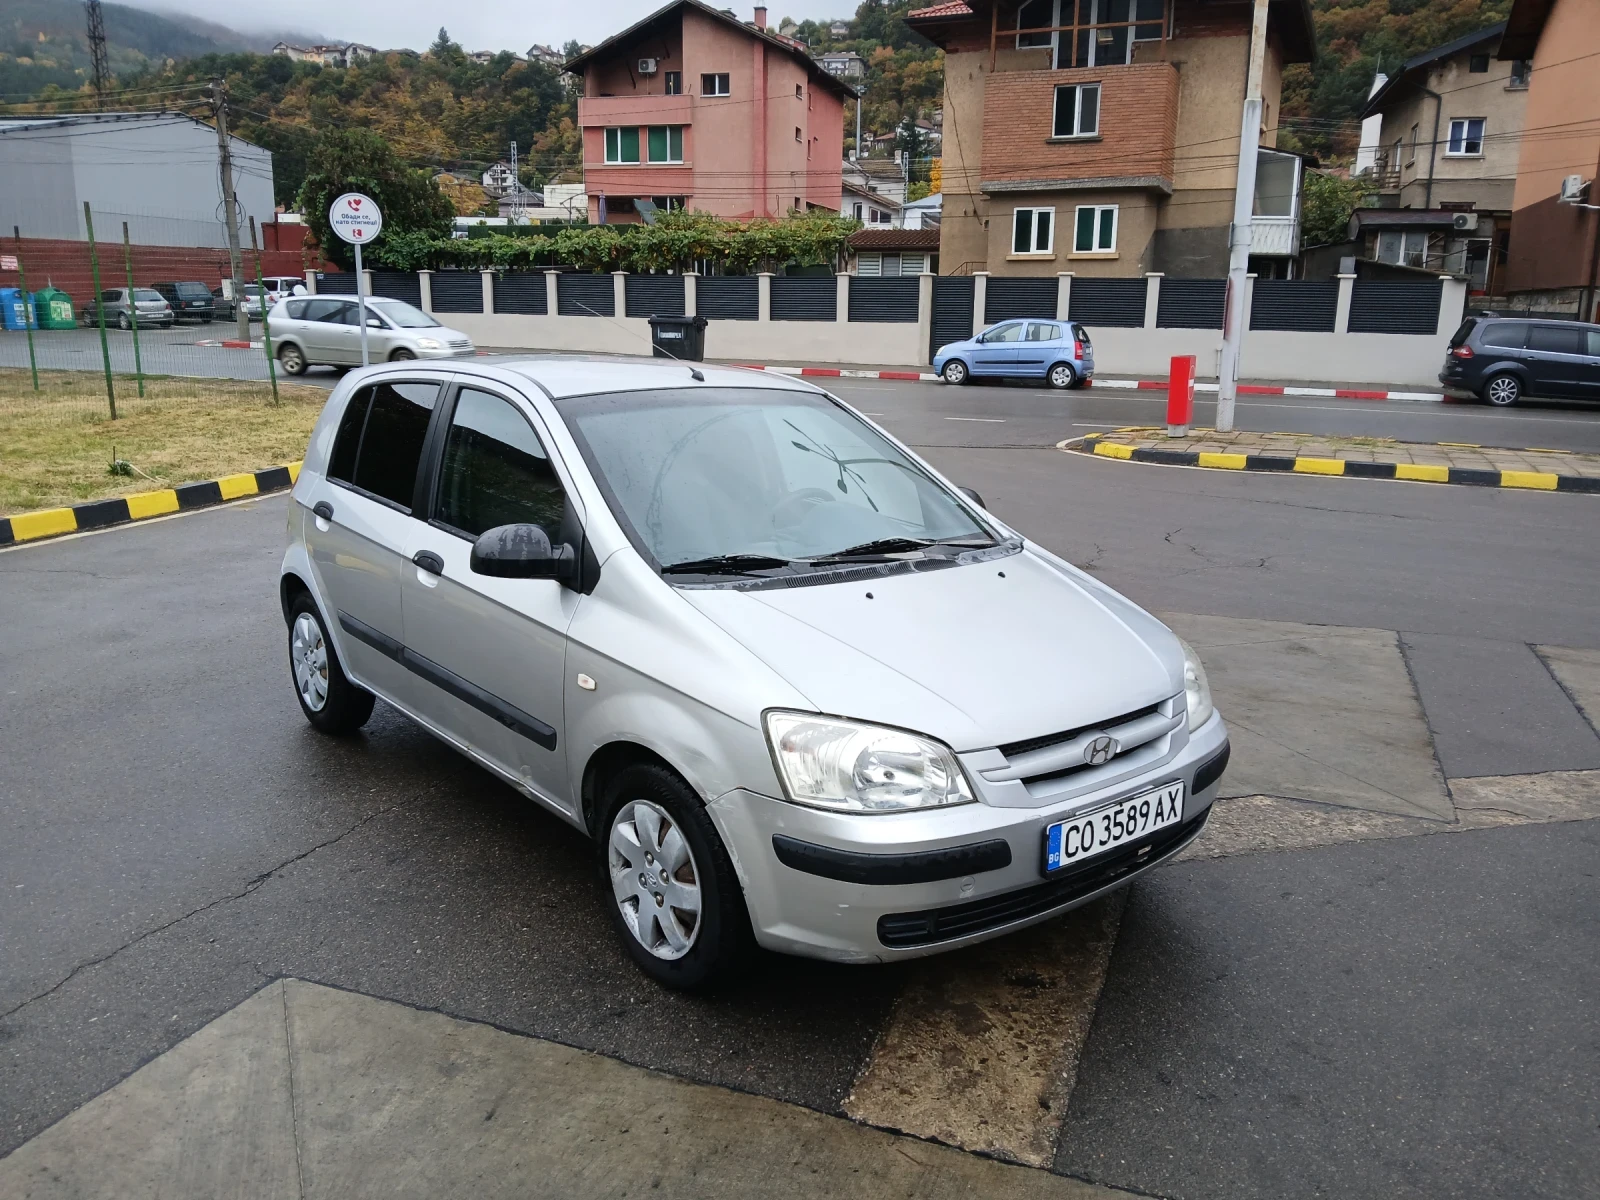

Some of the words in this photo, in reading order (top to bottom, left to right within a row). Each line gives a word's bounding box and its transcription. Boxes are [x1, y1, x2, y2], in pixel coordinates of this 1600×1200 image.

[1064, 820, 1095, 858] CO
[1098, 800, 1151, 846] 3589
[1153, 788, 1180, 826] AX
[1048, 851, 1060, 864] BG
